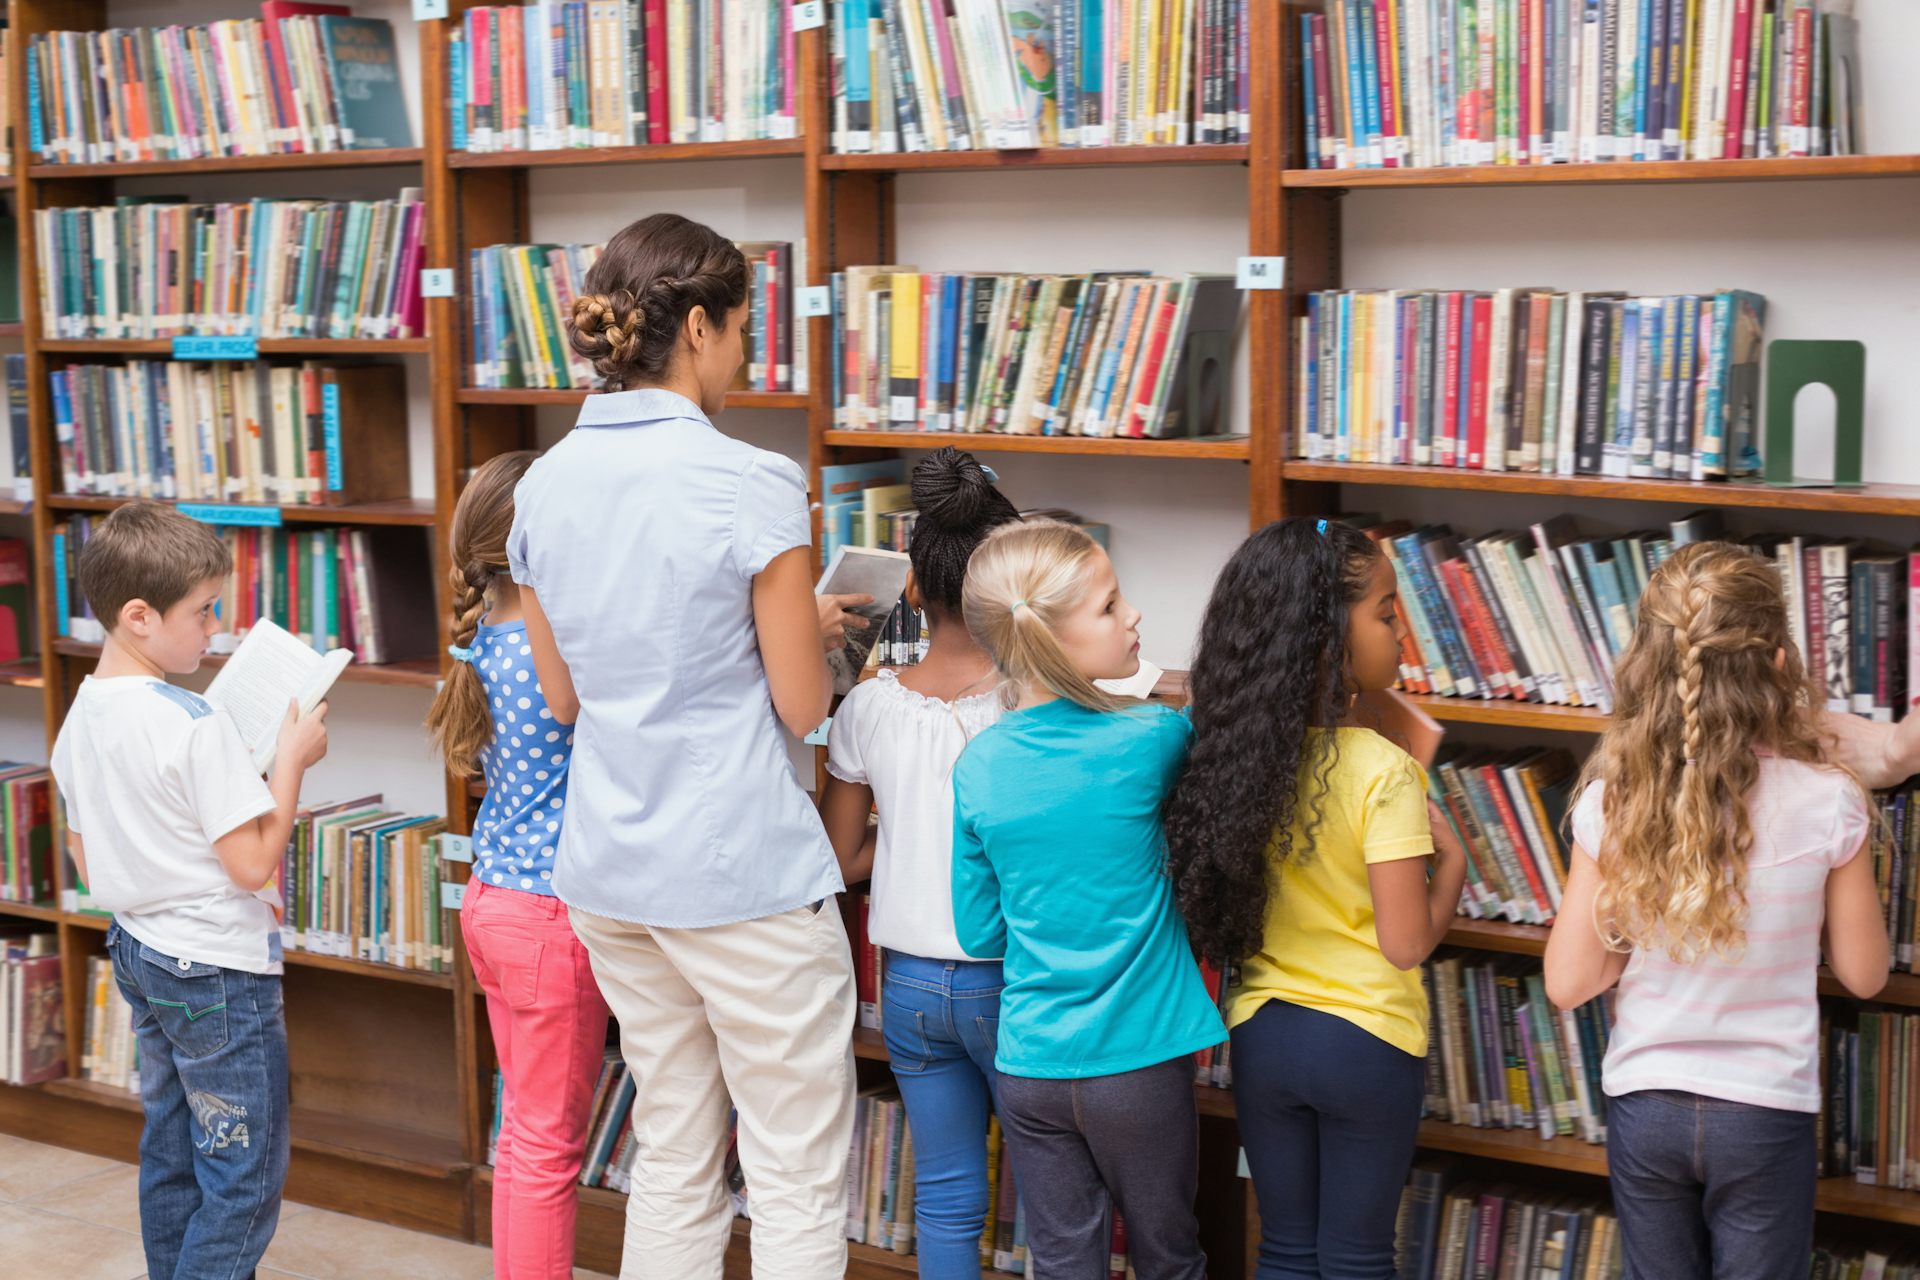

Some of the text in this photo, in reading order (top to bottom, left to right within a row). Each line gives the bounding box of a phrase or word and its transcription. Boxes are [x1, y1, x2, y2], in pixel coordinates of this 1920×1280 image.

[805, 5, 814, 17] G
[1250, 263, 1267, 277] M
[810, 297, 821, 308] H
[1875, 572, 1889, 602] JOHN
[1876, 604, 1889, 639] MILES
[454, 840, 461, 851] D
[455, 888, 461, 900] E
